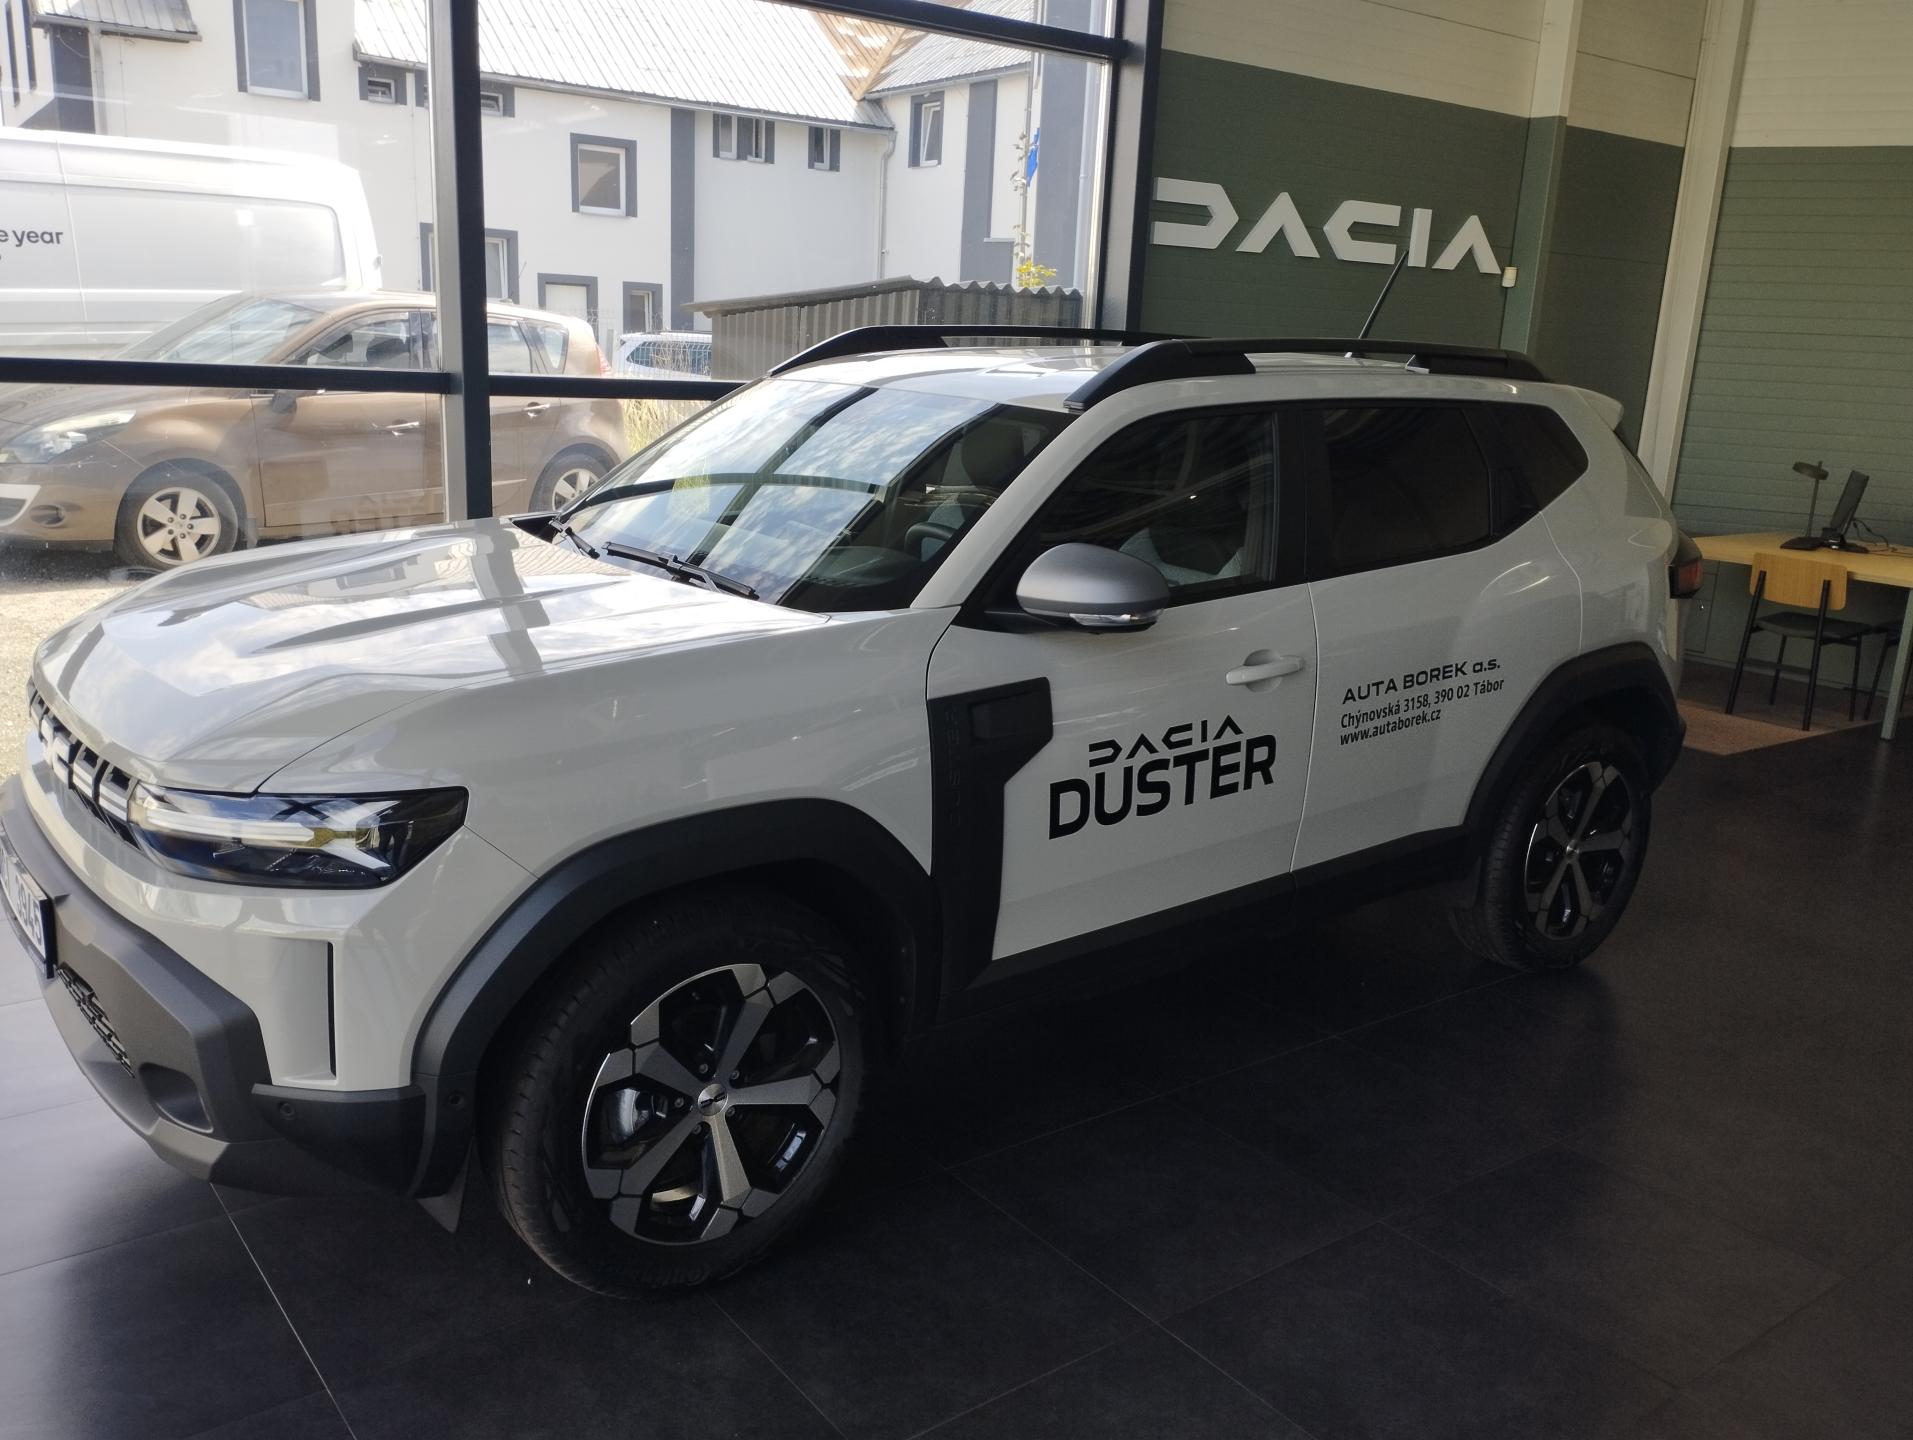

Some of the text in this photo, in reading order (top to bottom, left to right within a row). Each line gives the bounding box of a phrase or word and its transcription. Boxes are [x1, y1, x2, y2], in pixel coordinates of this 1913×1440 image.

[12, 230, 63, 247] year
[1150, 177, 1502, 275] DACIA
[1341, 679, 1504, 730] Chýnovská 3158, 390 02 Tábor
[1342, 659, 1501, 704] AUTA BOREK a.s.
[1088, 714, 1244, 768] DACIA
[1340, 709, 1442, 745] www.autaborek.cz
[1049, 734, 1277, 840] DUSTER
